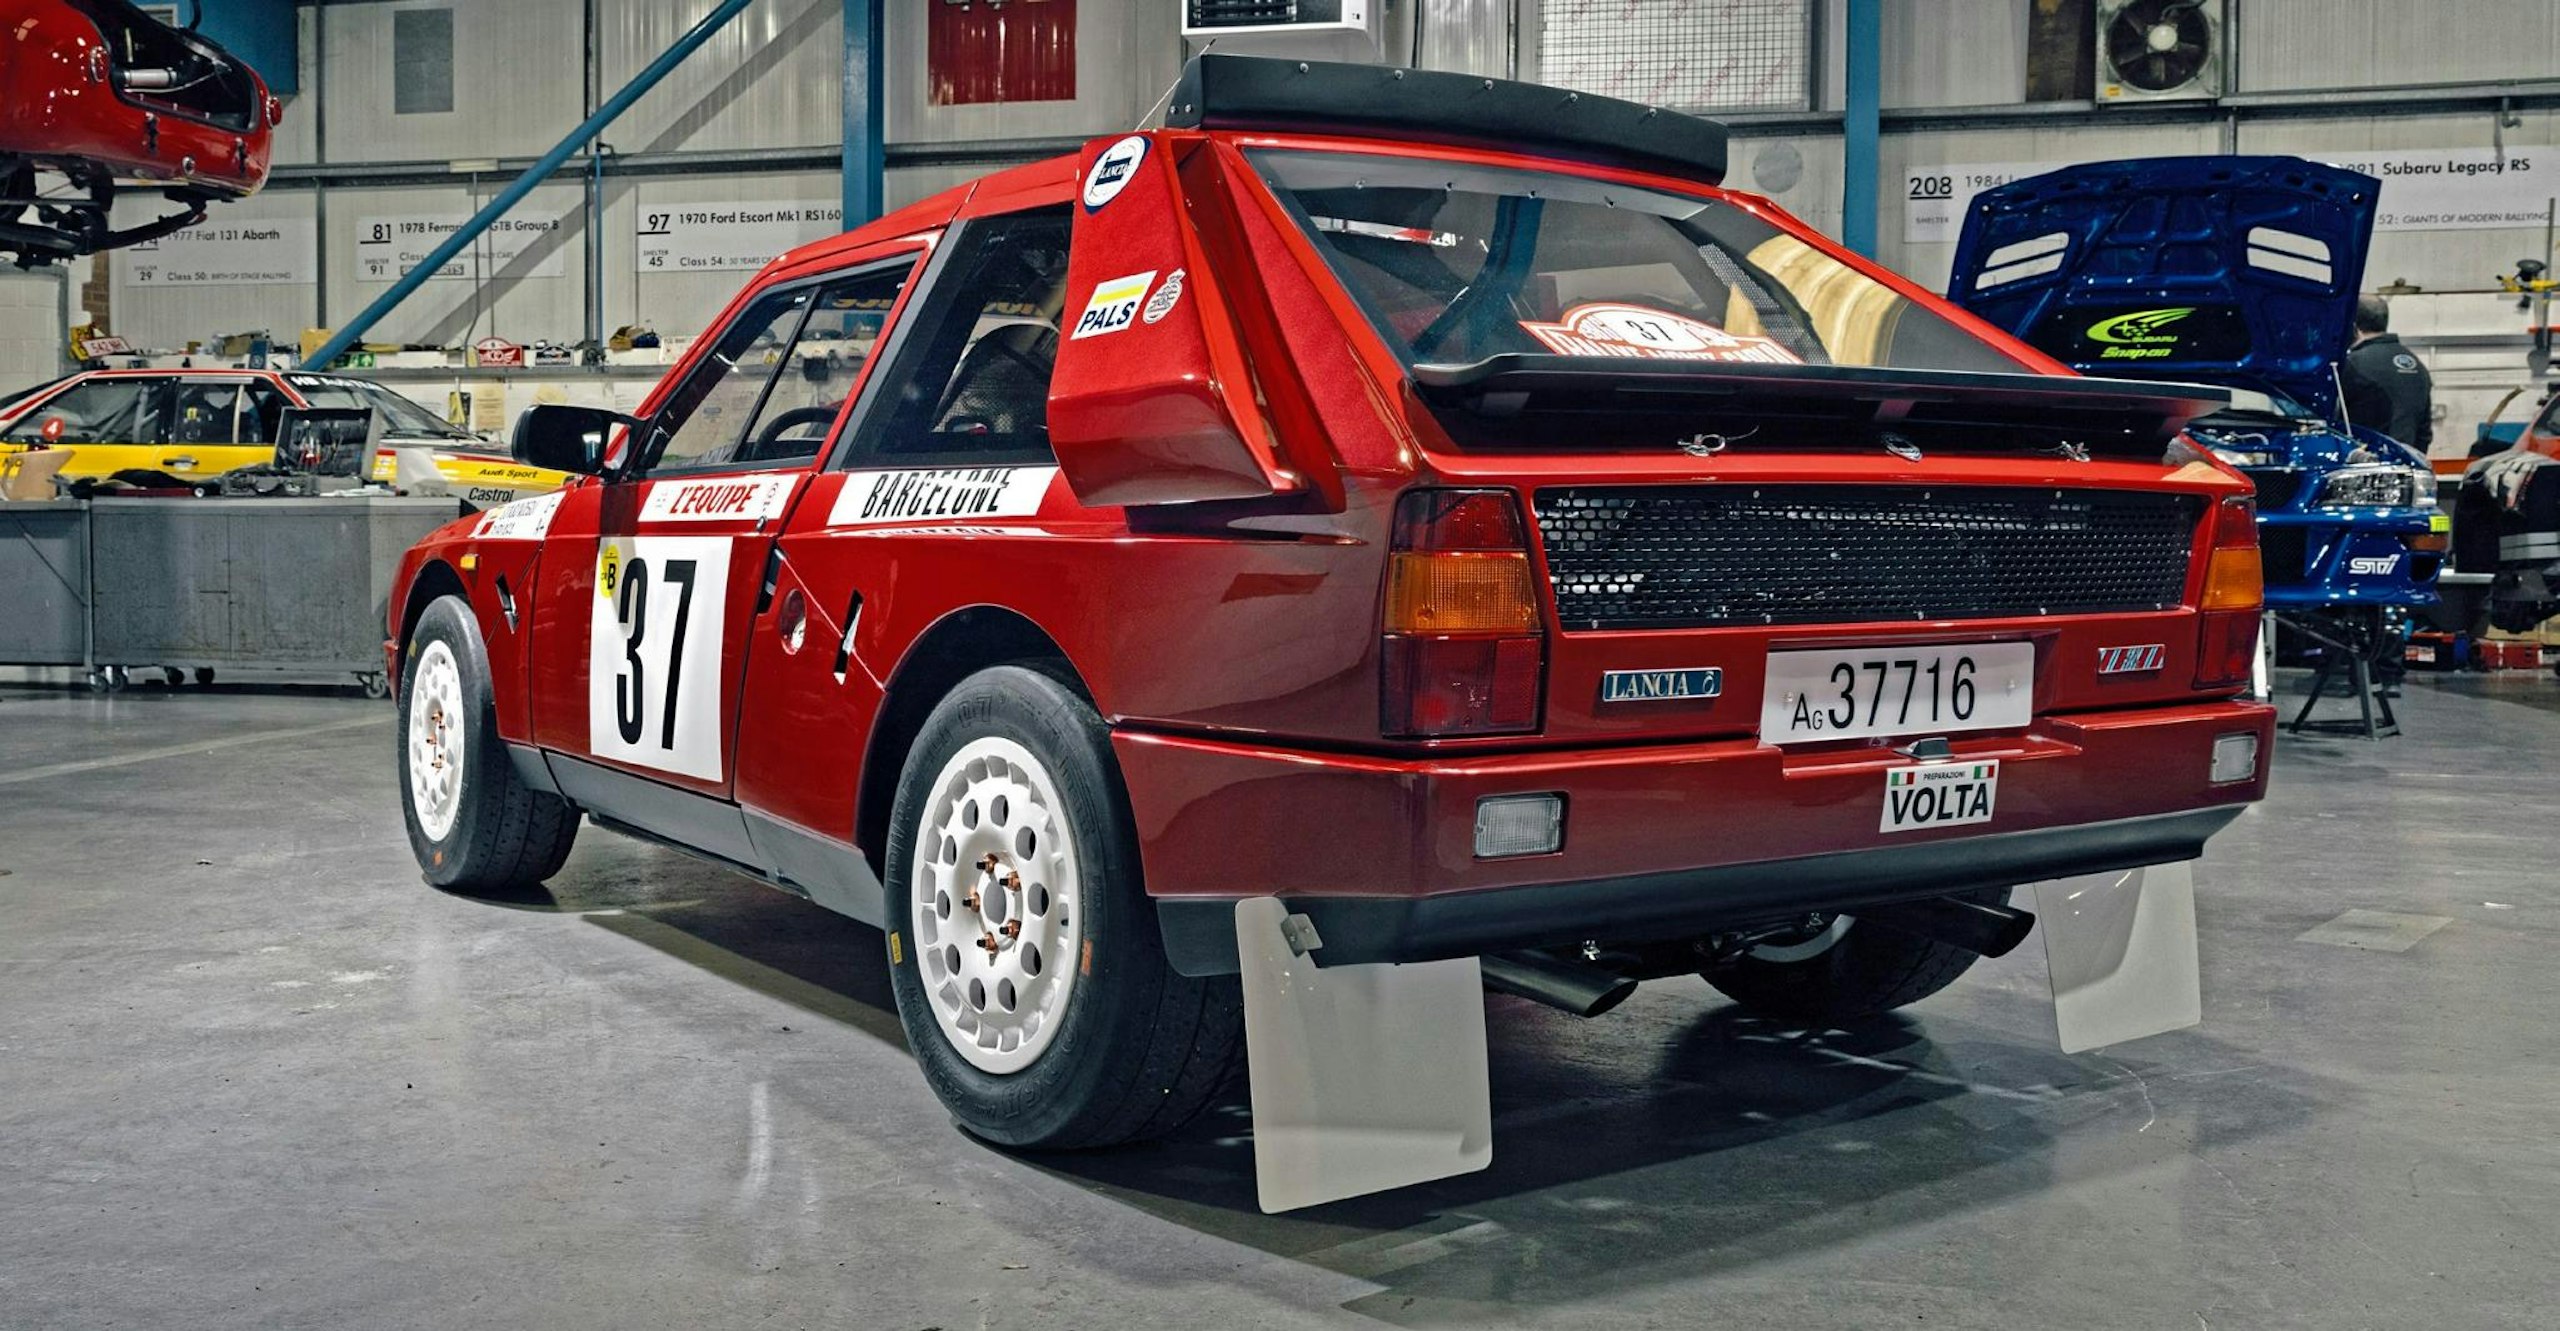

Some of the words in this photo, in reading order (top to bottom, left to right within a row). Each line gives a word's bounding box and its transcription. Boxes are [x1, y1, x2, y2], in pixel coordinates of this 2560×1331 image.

[2383, 162, 2442, 175] Subaru
[2448, 160, 2505, 175] Legacy
[2511, 158, 2531, 171] RS
[1909, 176, 1952, 195] 208
[1965, 175, 2003, 188] 1984
[648, 214, 670, 231] 97
[679, 213, 707, 225] 1970
[711, 211, 736, 224] Ford
[740, 211, 774, 224] Escort
[777, 210, 800, 222] Mk1
[2403, 214, 2438, 224] GIANTS
[2441, 213, 2455, 223] OF
[2458, 212, 2501, 223] MODERN
[2505, 211, 2552, 222] RALLYING
[373, 223, 391, 240] 81
[400, 222, 425, 233] 1978
[515, 220, 549, 232] Group
[552, 219, 559, 231] B
[196, 229, 215, 241] Fiat
[220, 230, 238, 241] 131
[242, 229, 280, 241] Abarth
[649, 256, 664, 267] 45
[680, 257, 707, 267] Class
[139, 271, 152, 281] 29
[167, 272, 192, 281] Class
[370, 264, 383, 275] 91
[1078, 301, 1136, 333] PALS
[1625, 320, 1674, 342] 37
[47, 421, 58, 434] 4
[479, 468, 505, 477] Audi
[507, 468, 538, 479] Sport
[468, 487, 515, 503] Castrol
[607, 563, 616, 590] B
[617, 557, 698, 751] 37
[1610, 672, 1690, 699] LANCIA
[1828, 656, 1976, 730] 37716
[1922, 770, 1966, 782] PREPARAZIONI
[1890, 782, 1990, 826] VOLTA
